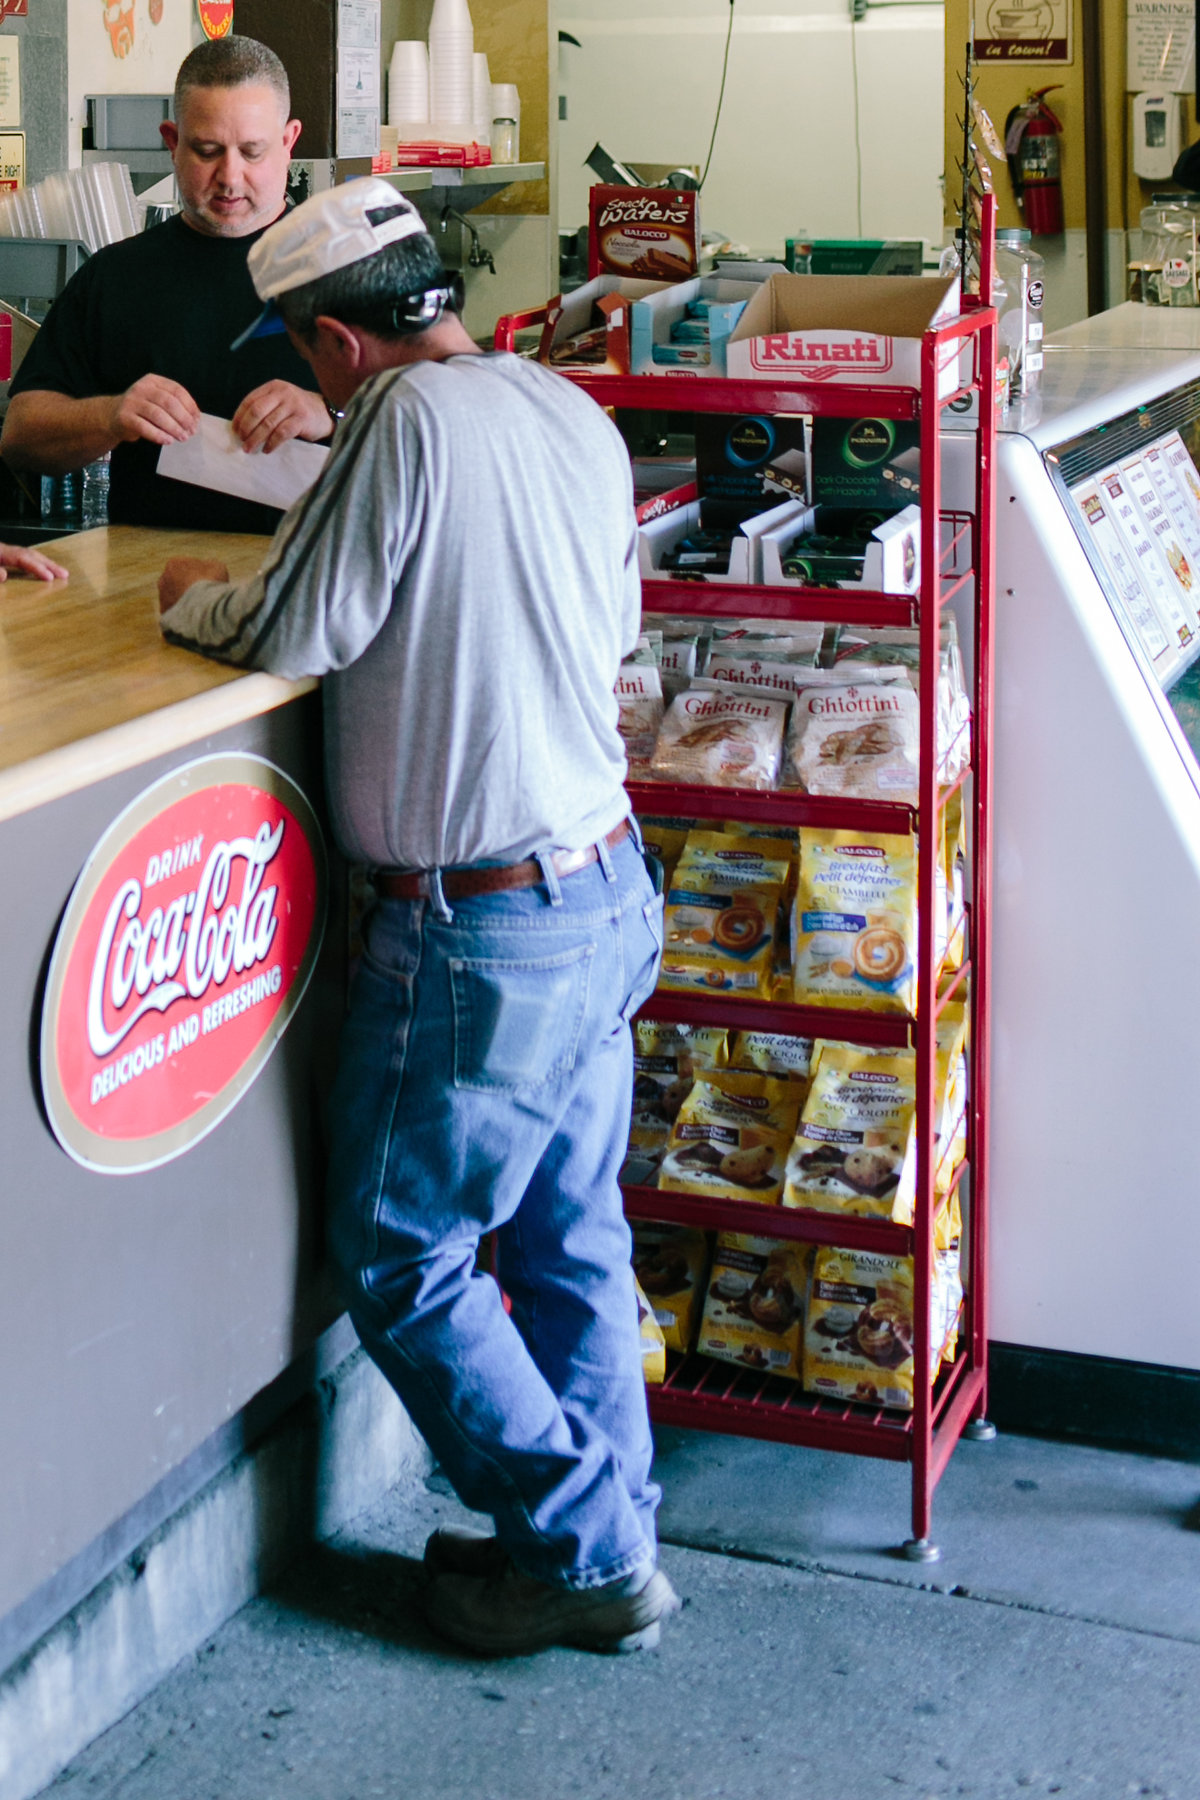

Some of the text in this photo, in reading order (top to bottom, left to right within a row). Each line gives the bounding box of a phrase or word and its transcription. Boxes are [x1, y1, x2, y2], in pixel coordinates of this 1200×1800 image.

[986, 39, 1052, 56] in town!
[5, 165, 20, 178] RIGHT
[599, 201, 688, 227] wafers
[624, 229, 668, 239] BALOCCO
[761, 334, 880, 362] Rinati
[685, 698, 770, 717] Ghiottini
[808, 695, 899, 714] Ghiottini
[145, 834, 204, 888] DRINK
[836, 847, 884, 857] BALOCCO
[829, 861, 890, 875] Breakfast
[88, 818, 284, 1057] Coca-Cola
[90, 965, 282, 1105] DELICIOUS AND REFRESHING
[851, 1072, 897, 1083] BALOCCO
